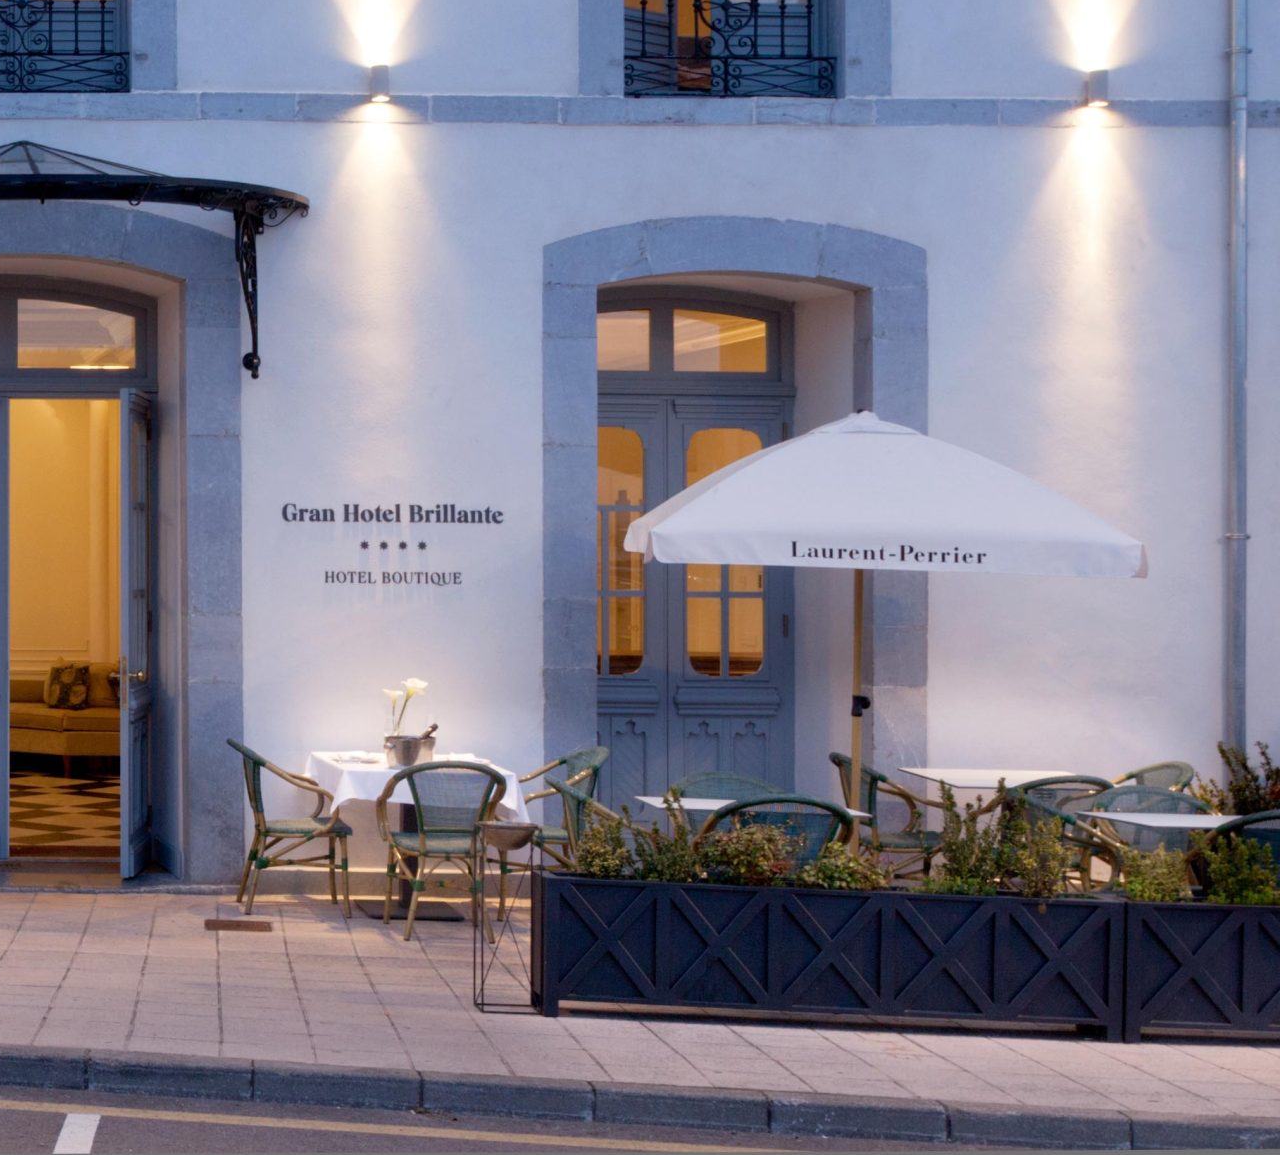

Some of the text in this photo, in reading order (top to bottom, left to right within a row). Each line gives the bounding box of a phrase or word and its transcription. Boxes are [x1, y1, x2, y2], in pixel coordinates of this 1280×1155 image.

[281, 503, 504, 524] Gran Hotel Brillante
[791, 540, 987, 564] Laurent-Perrier
[324, 571, 462, 586] HOTEL BOUTIQUE
